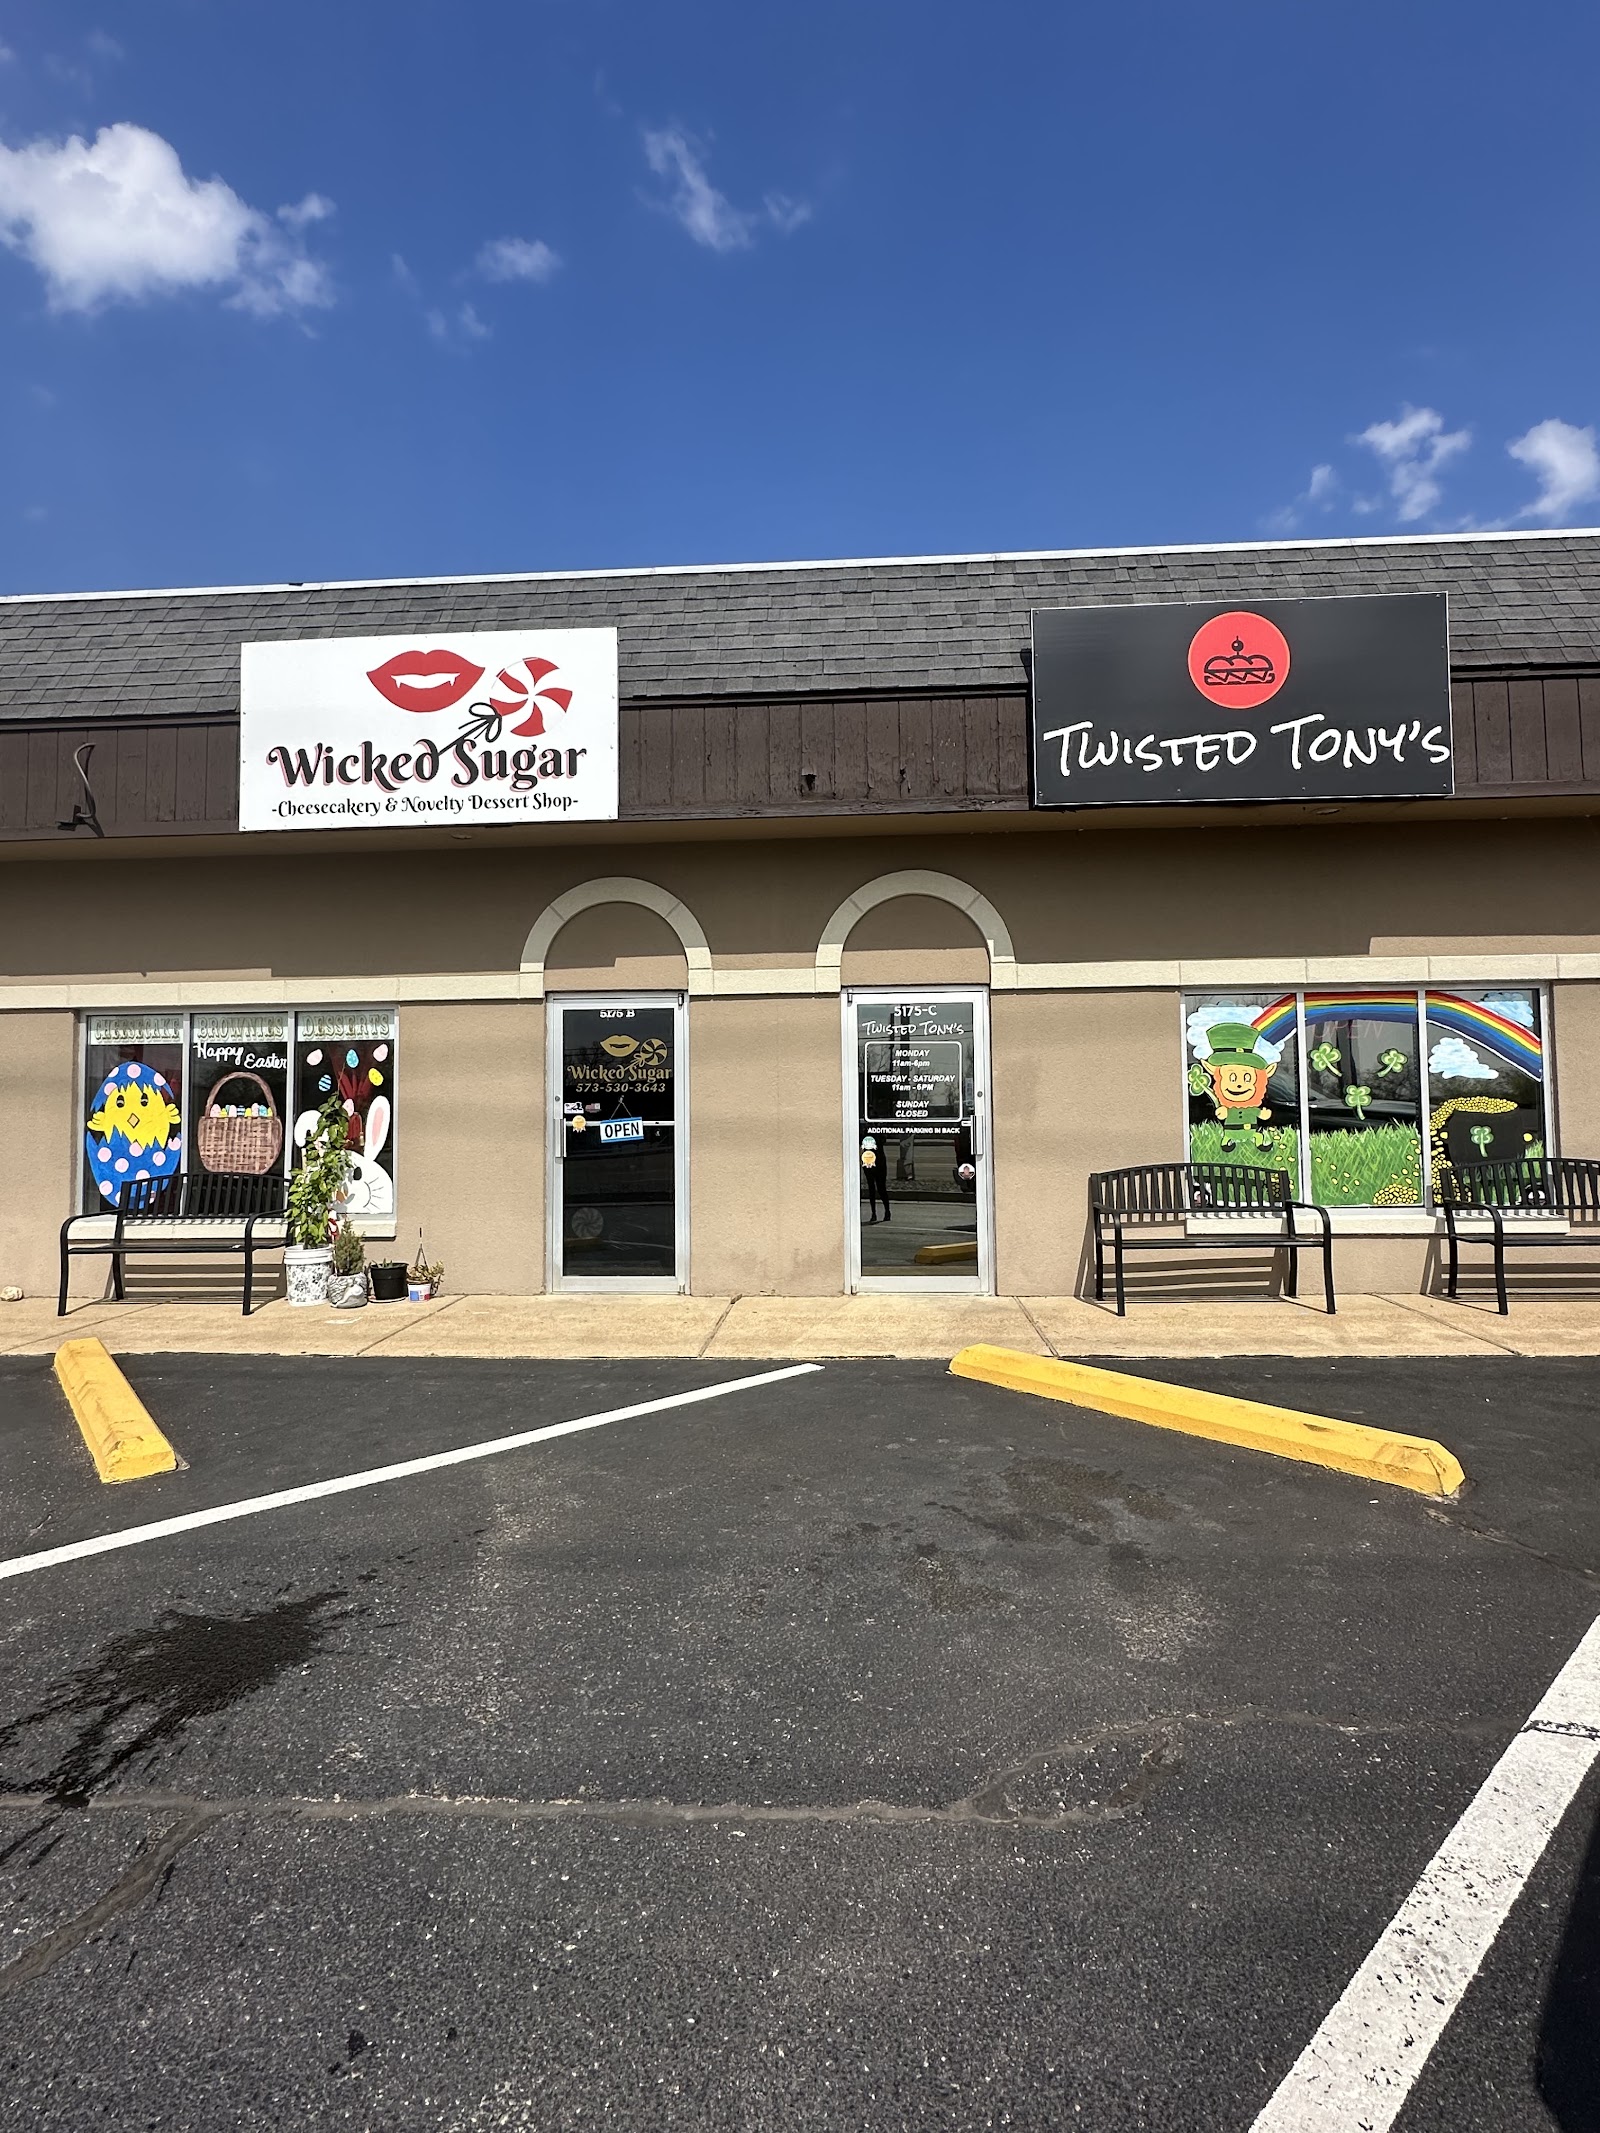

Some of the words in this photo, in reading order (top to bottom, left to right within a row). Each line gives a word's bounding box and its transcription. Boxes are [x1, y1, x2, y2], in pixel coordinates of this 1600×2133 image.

[1044, 720, 1258, 777] TWISTED
[1270, 713, 1451, 771] TONY'S
[266, 738, 440, 793] Wicked
[451, 739, 587, 793] Sugar
[271, 797, 381, 818] -Cheesecakery
[385, 796, 398, 812] &
[401, 795, 465, 814] Novelty
[467, 793, 530, 810] Dessert
[533, 792, 579, 811] Shop-
[600, 1009, 624, 1018] 5175
[626, 1009, 636, 1018] B
[894, 1005, 938, 1017] 5175-C
[94, 1015, 181, 1041] CHEESECAKE
[197, 1014, 285, 1041] BROWNIES
[302, 1013, 390, 1039] DESSERTS
[862, 1020, 917, 1036] TWISTED
[919, 1020, 964, 1036] TONY'S
[193, 1040, 244, 1066] Happy
[244, 1052, 288, 1069] Easter
[895, 1049, 931, 1057] MONDAY
[892, 1059, 930, 1068] 11am-6pm
[566, 1064, 626, 1082] Wicked
[628, 1065, 673, 1083] Sugar
[871, 1074, 908, 1082] TUESDAY
[912, 1074, 956, 1082] SATURDAY
[576, 1082, 666, 1093] 573-530-3643
[892, 1083, 911, 1091] 11am
[916, 1083, 934, 1091] 6PM
[896, 1100, 930, 1108] SUNDAY
[895, 1109, 929, 1117] CLOSED
[604, 1121, 640, 1139] OPEN
